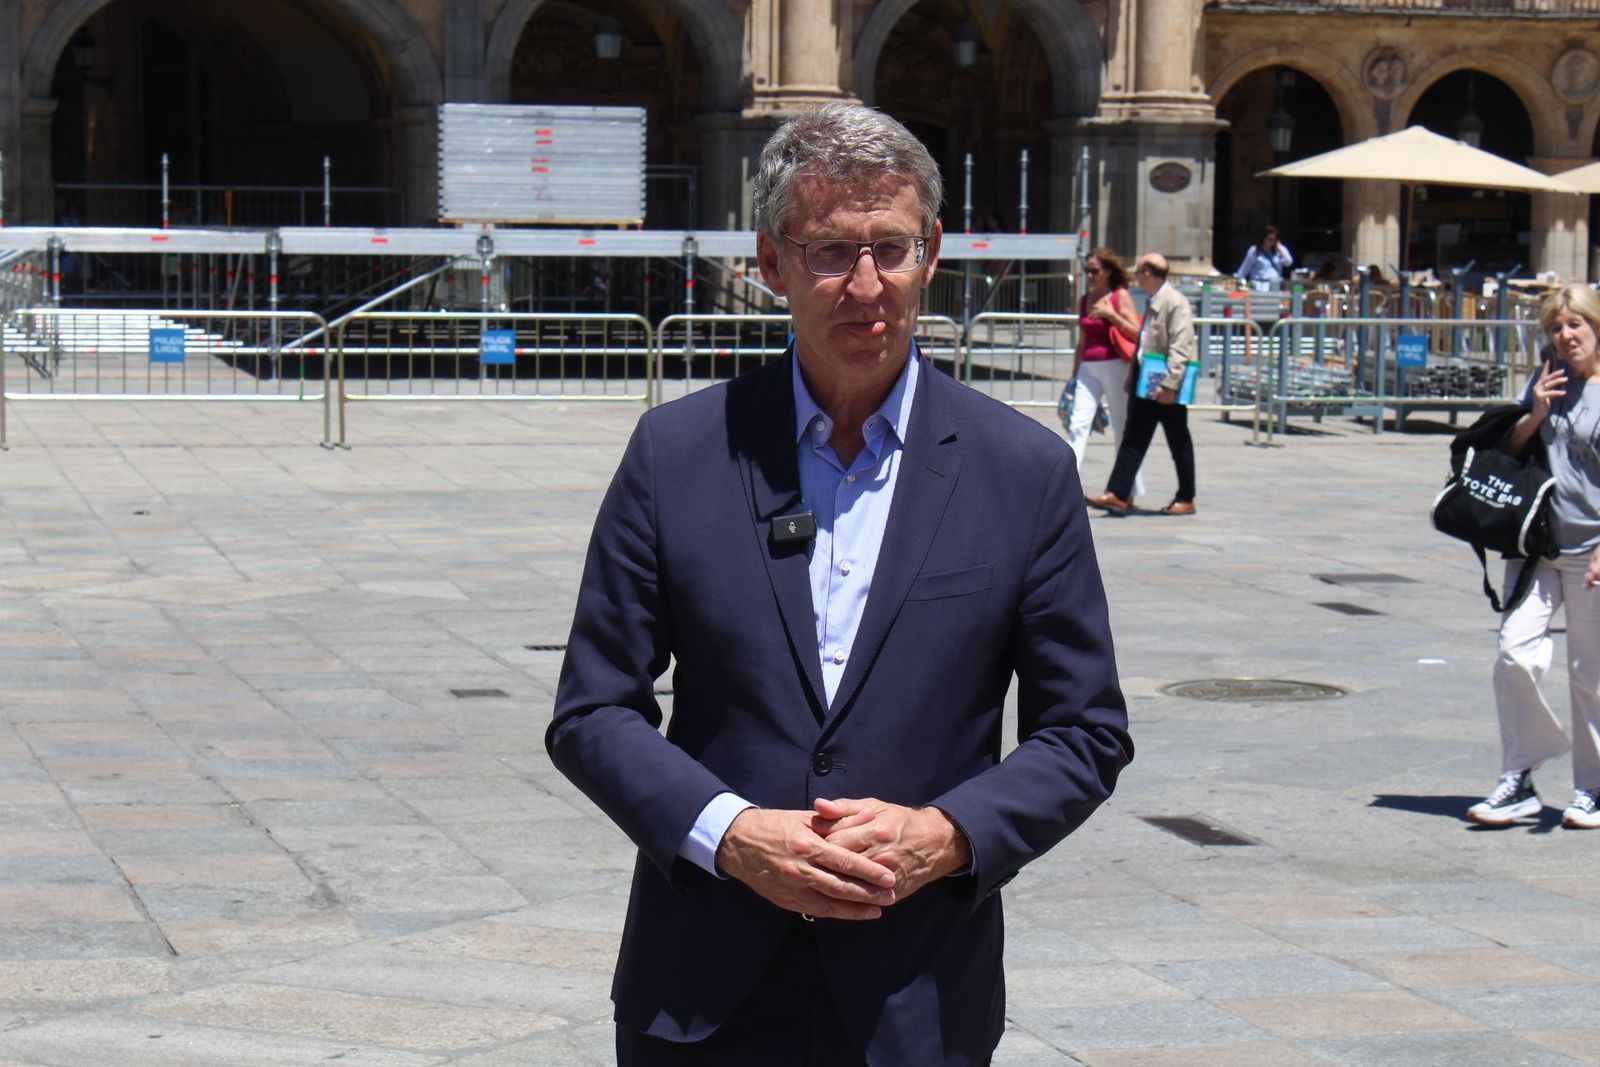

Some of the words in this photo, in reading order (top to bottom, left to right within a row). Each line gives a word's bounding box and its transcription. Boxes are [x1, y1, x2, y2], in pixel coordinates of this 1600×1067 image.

[1463, 476, 1496, 499] TOTE
[1497, 493, 1523, 506] BAG
[1488, 475, 1513, 493] THE
